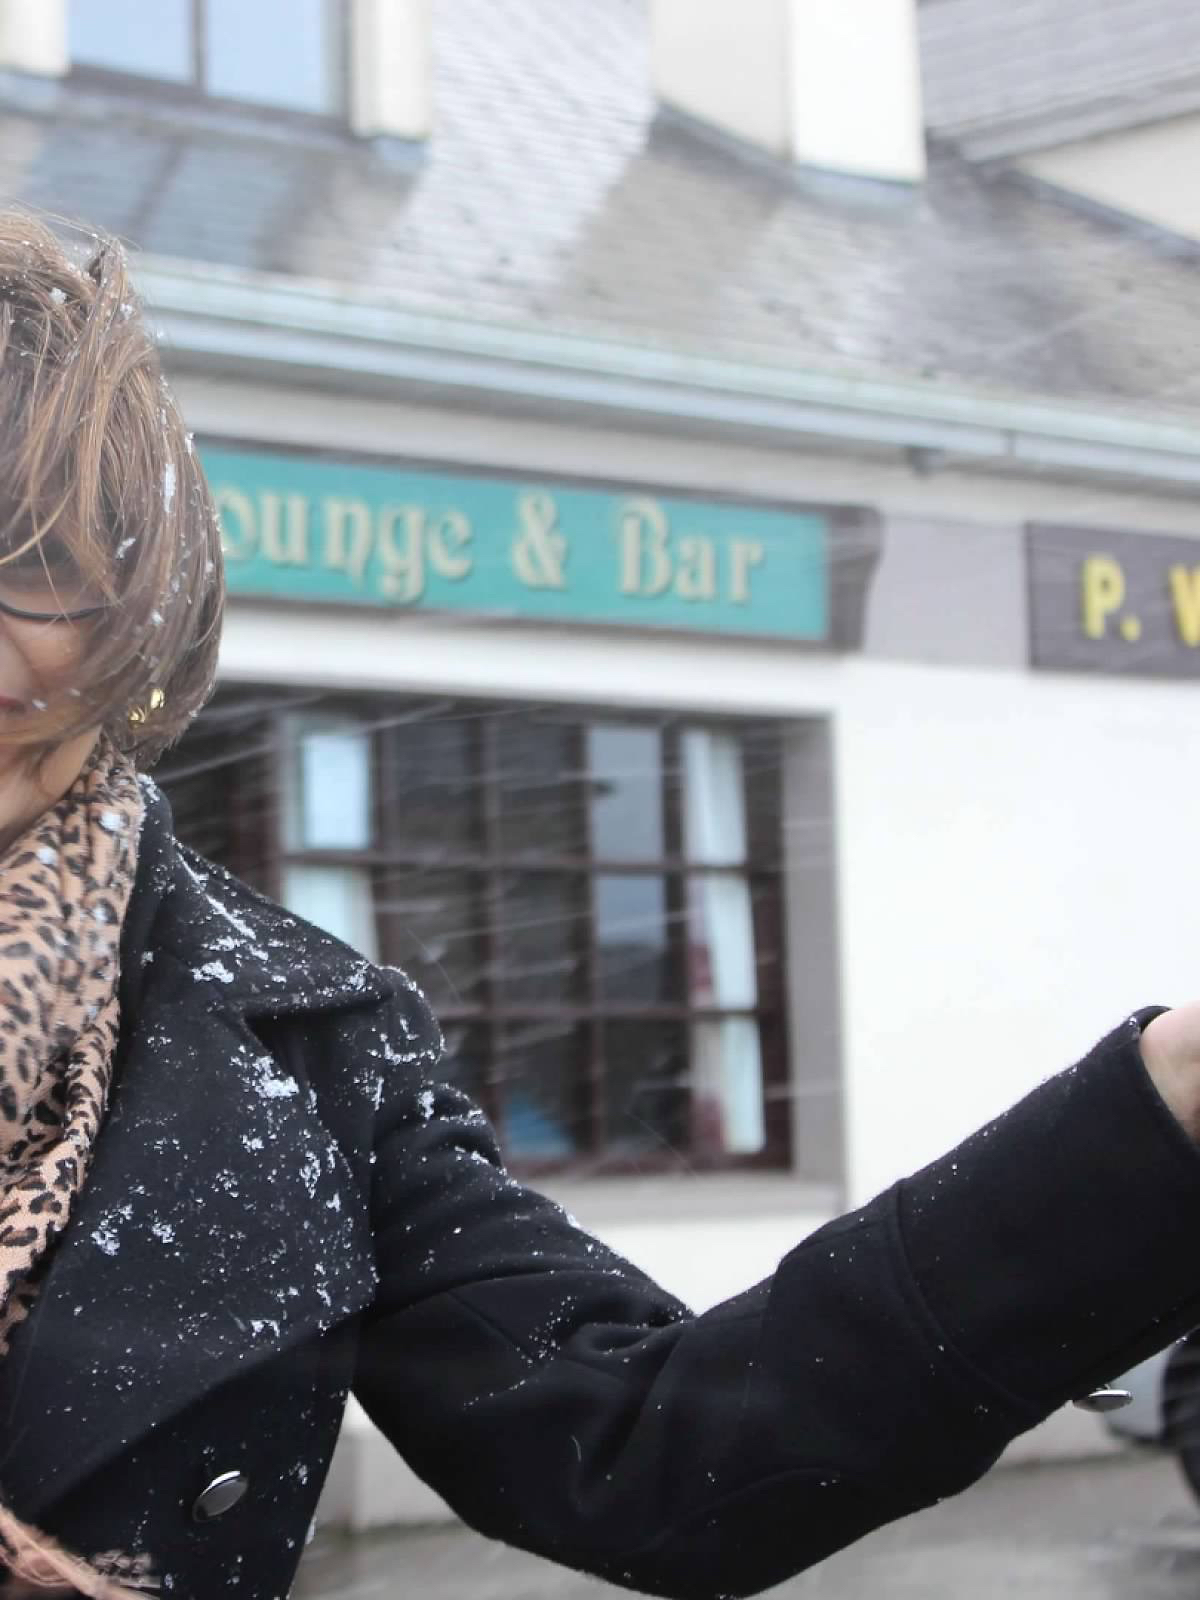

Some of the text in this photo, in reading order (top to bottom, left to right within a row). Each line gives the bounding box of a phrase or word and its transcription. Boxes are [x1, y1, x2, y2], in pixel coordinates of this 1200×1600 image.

[215, 485, 764, 605] ounge & Bar
[1081, 552, 1141, 640] P.
